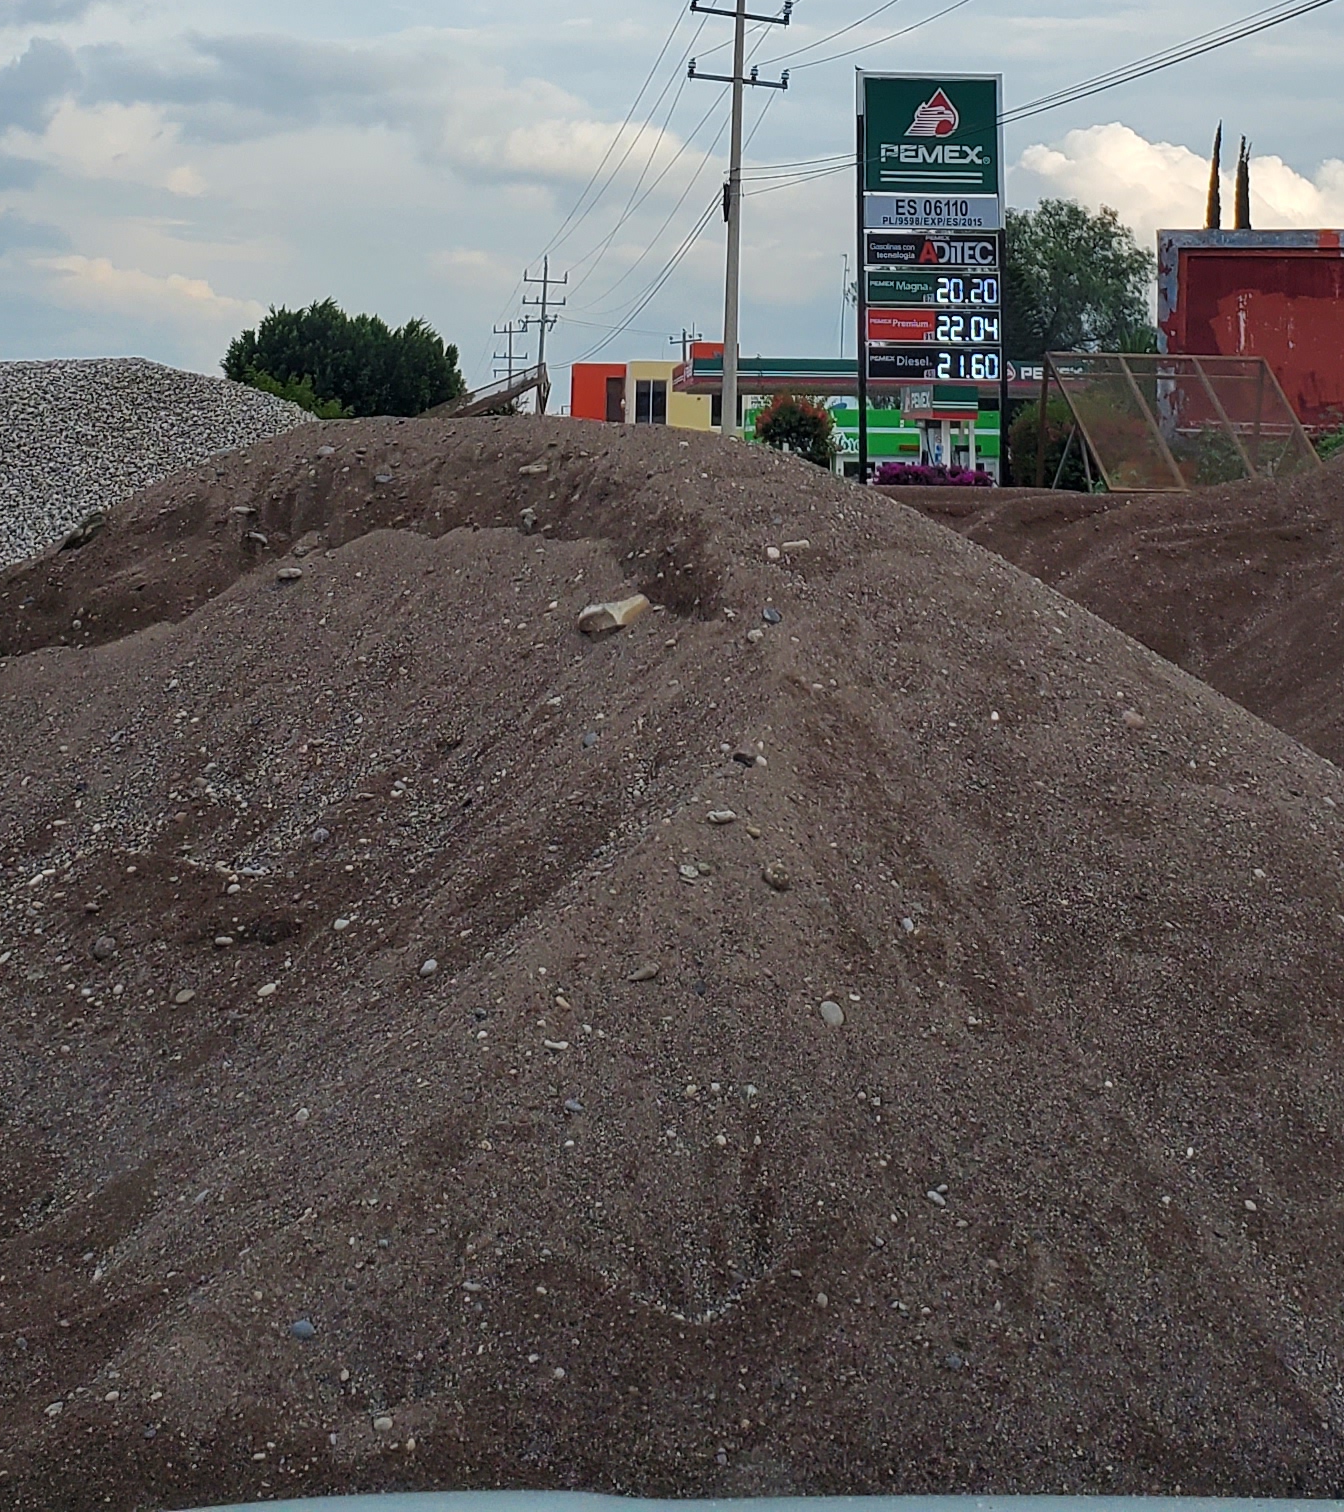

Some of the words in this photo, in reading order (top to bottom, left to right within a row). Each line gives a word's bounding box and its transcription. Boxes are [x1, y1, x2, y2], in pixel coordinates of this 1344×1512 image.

[880, 144, 983, 164] PEMEX
[896, 199, 917, 216] ES
[923, 200, 968, 217] 06110
[882, 216, 983, 227] PL/9598/EXP/ES/2015
[869, 243, 902, 251] Gasolinas
[896, 281, 929, 292] Magna
[936, 277, 997, 303] 20.20
[892, 319, 929, 328] Premium
[936, 315, 998, 341] 22.04
[896, 356, 929, 367] Diesel
[937, 353, 999, 379] 21.60
